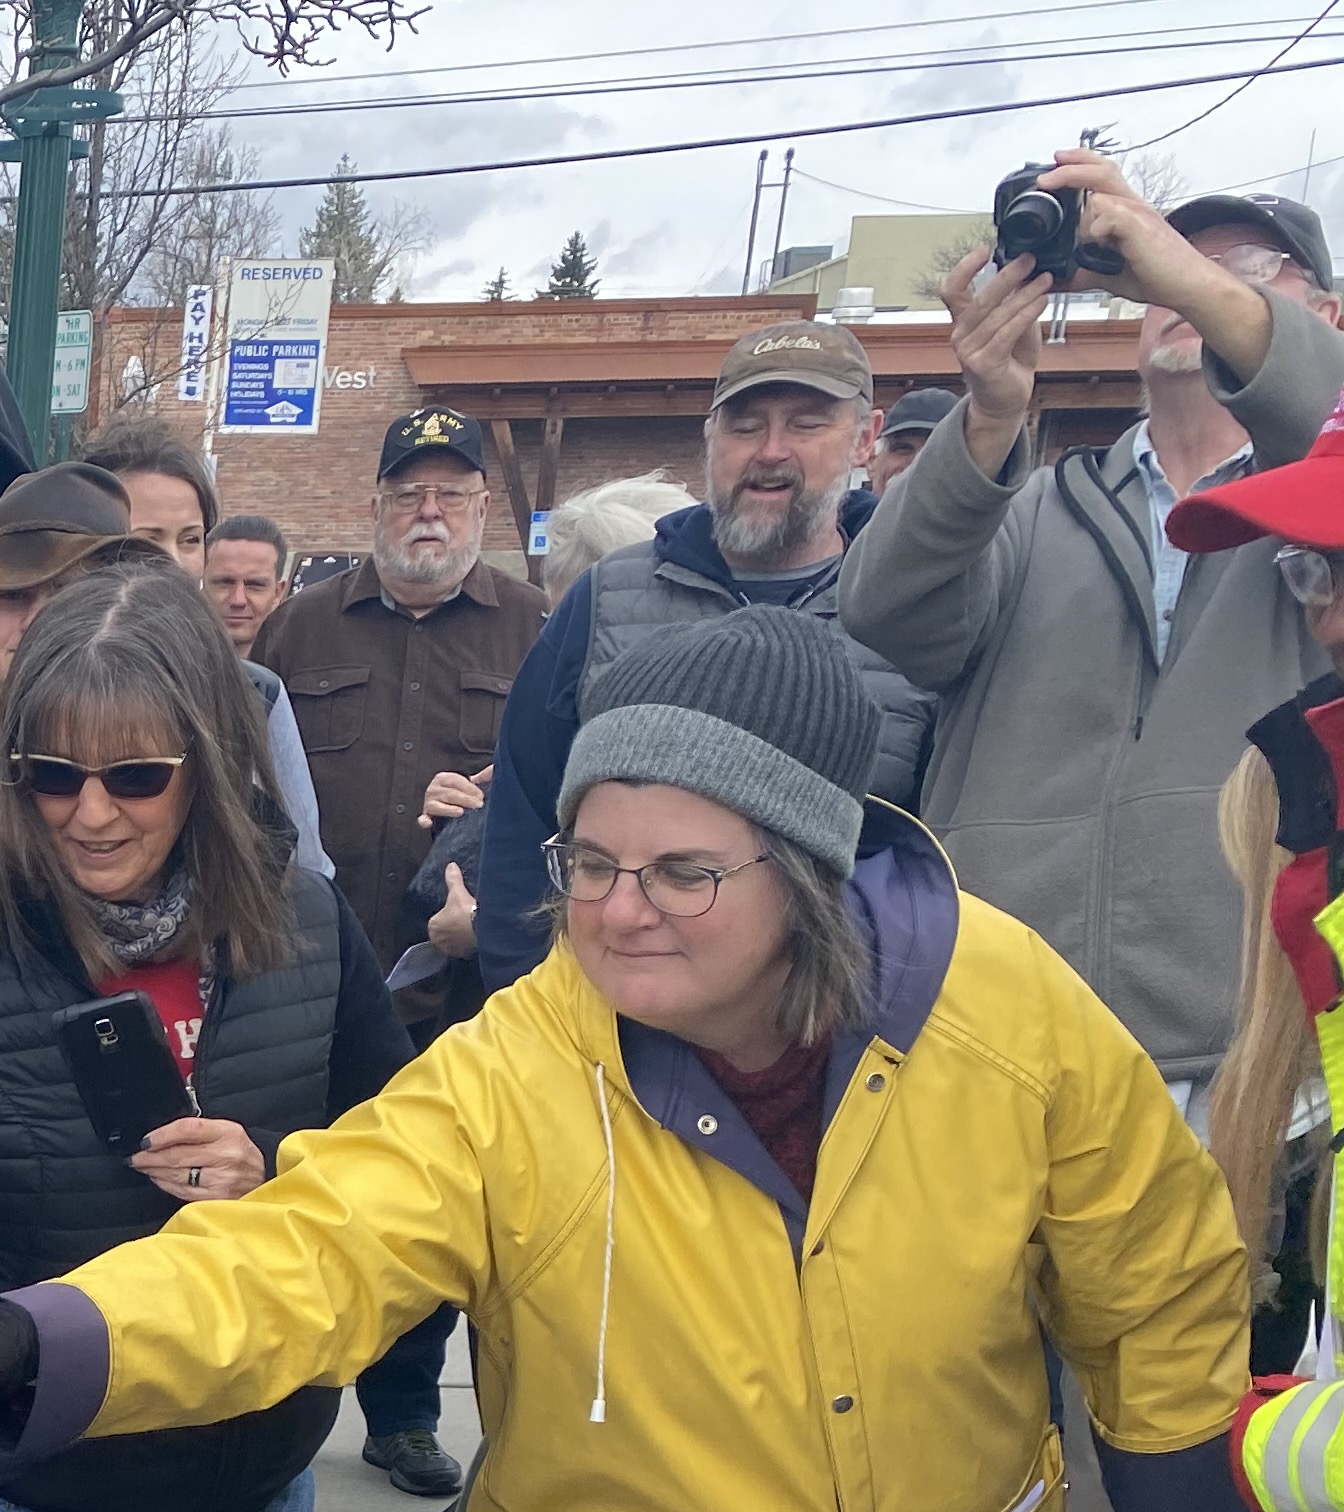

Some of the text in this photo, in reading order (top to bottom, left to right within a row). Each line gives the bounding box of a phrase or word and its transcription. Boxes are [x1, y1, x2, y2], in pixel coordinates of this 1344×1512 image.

[241, 267, 323, 280] RESERVED
[234, 345, 316, 357] PUBLIC PARKING
[432, 413, 464, 430] ARMY
